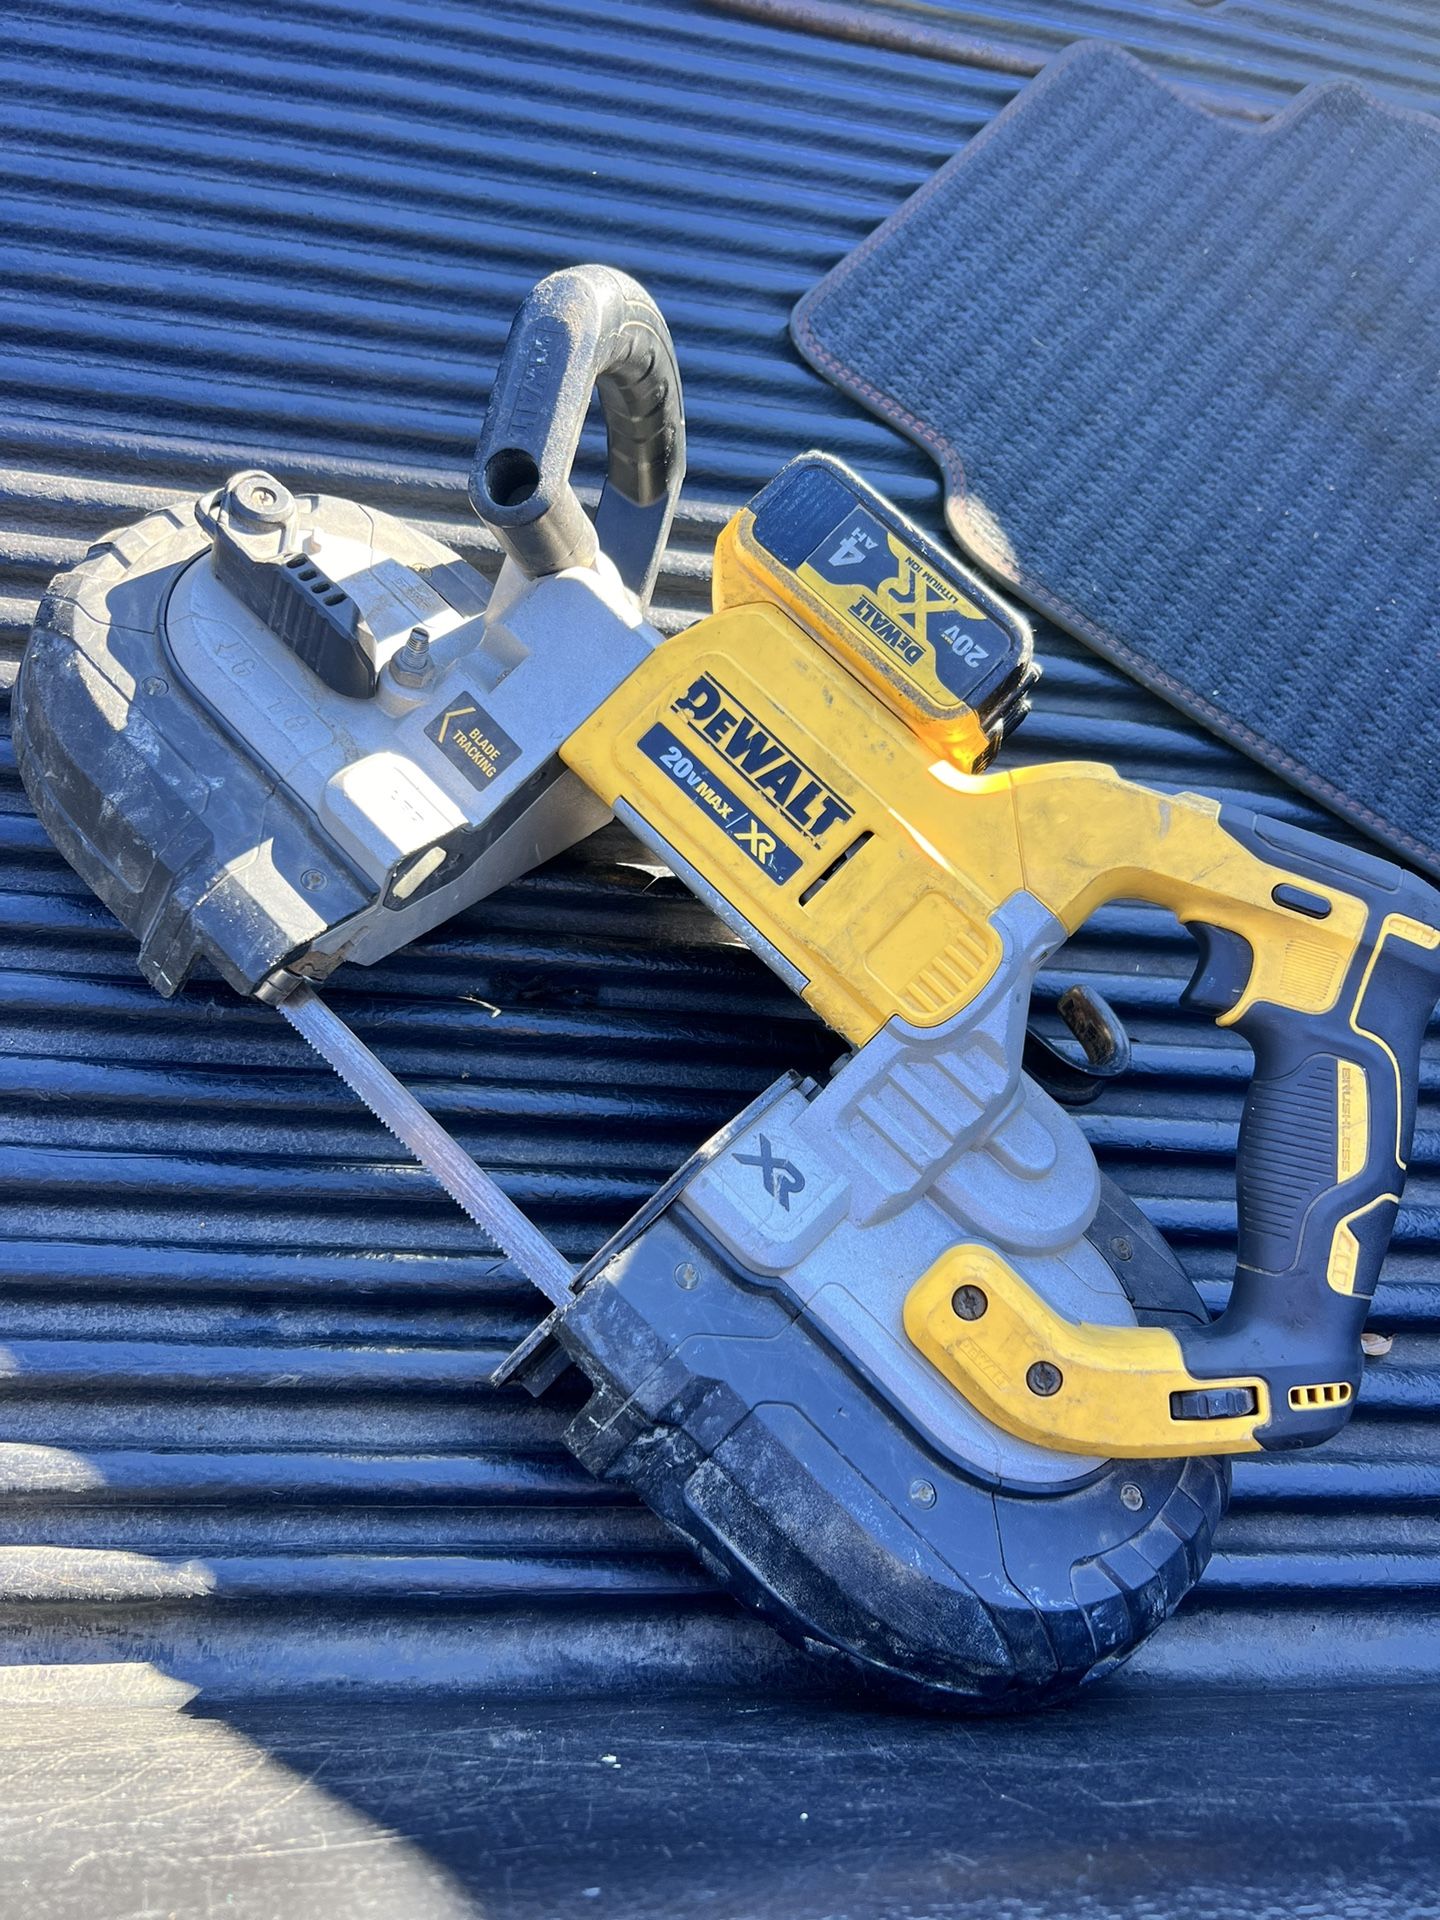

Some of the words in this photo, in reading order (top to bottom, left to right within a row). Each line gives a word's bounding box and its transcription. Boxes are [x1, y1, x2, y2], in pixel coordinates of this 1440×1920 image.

[828, 537, 866, 566] 4
[851, 527, 878, 550] AH
[905, 556, 922, 575] ION
[877, 560, 955, 640] XR
[922, 571, 958, 604] LITHIUM
[944, 625, 989, 668] 20V
[453, 729, 497, 778] TRACKING
[469, 728, 501, 761] BLADE
[734, 819, 777, 865] XR
[1341, 1067, 1352, 1173] BRUSHLESS
[732, 1132, 806, 1213] XR
